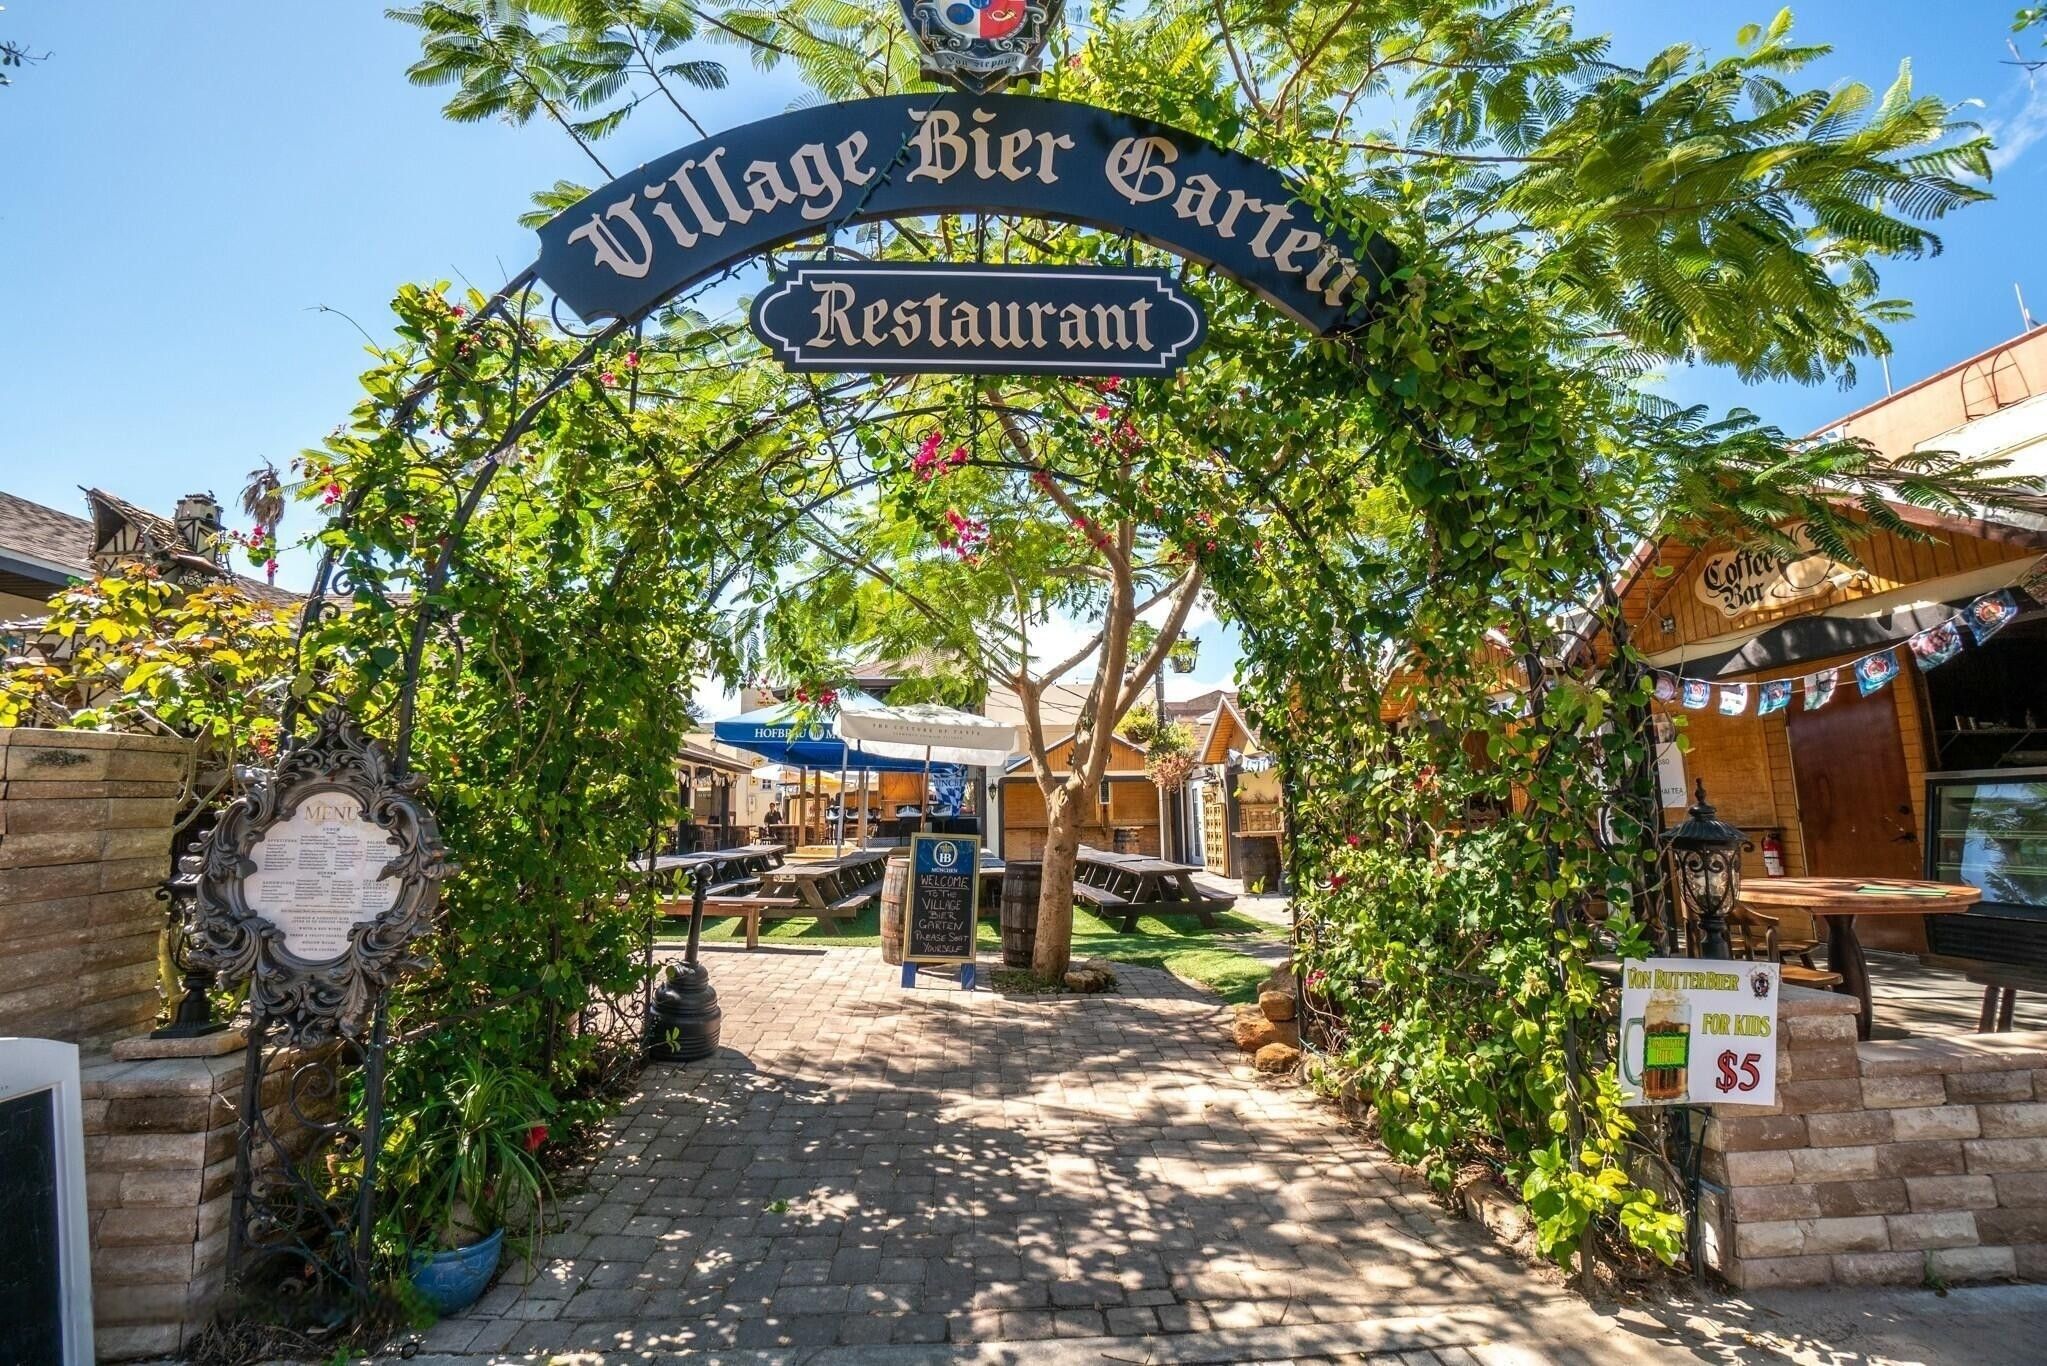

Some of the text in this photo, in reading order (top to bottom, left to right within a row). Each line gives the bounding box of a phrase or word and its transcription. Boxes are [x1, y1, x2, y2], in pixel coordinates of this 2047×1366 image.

[569, 106, 1359, 306] Village Bier Garten
[805, 279, 1156, 352] Restaurant
[1704, 548, 1775, 597] Coffee
[1719, 582, 1764, 616] Bar
[754, 728, 807, 738] HOFBRU
[303, 806, 361, 820] MENU
[939, 852, 953, 863] HB
[920, 874, 969, 888] WELCOME
[921, 897, 963, 910] VILLAGE
[928, 910, 957, 920] BIER
[918, 918, 964, 930] GARTEN
[913, 930, 946, 941] PLEASE
[1701, 1013, 1772, 1037] FOR KIDS
[1715, 1049, 1762, 1094] $5
